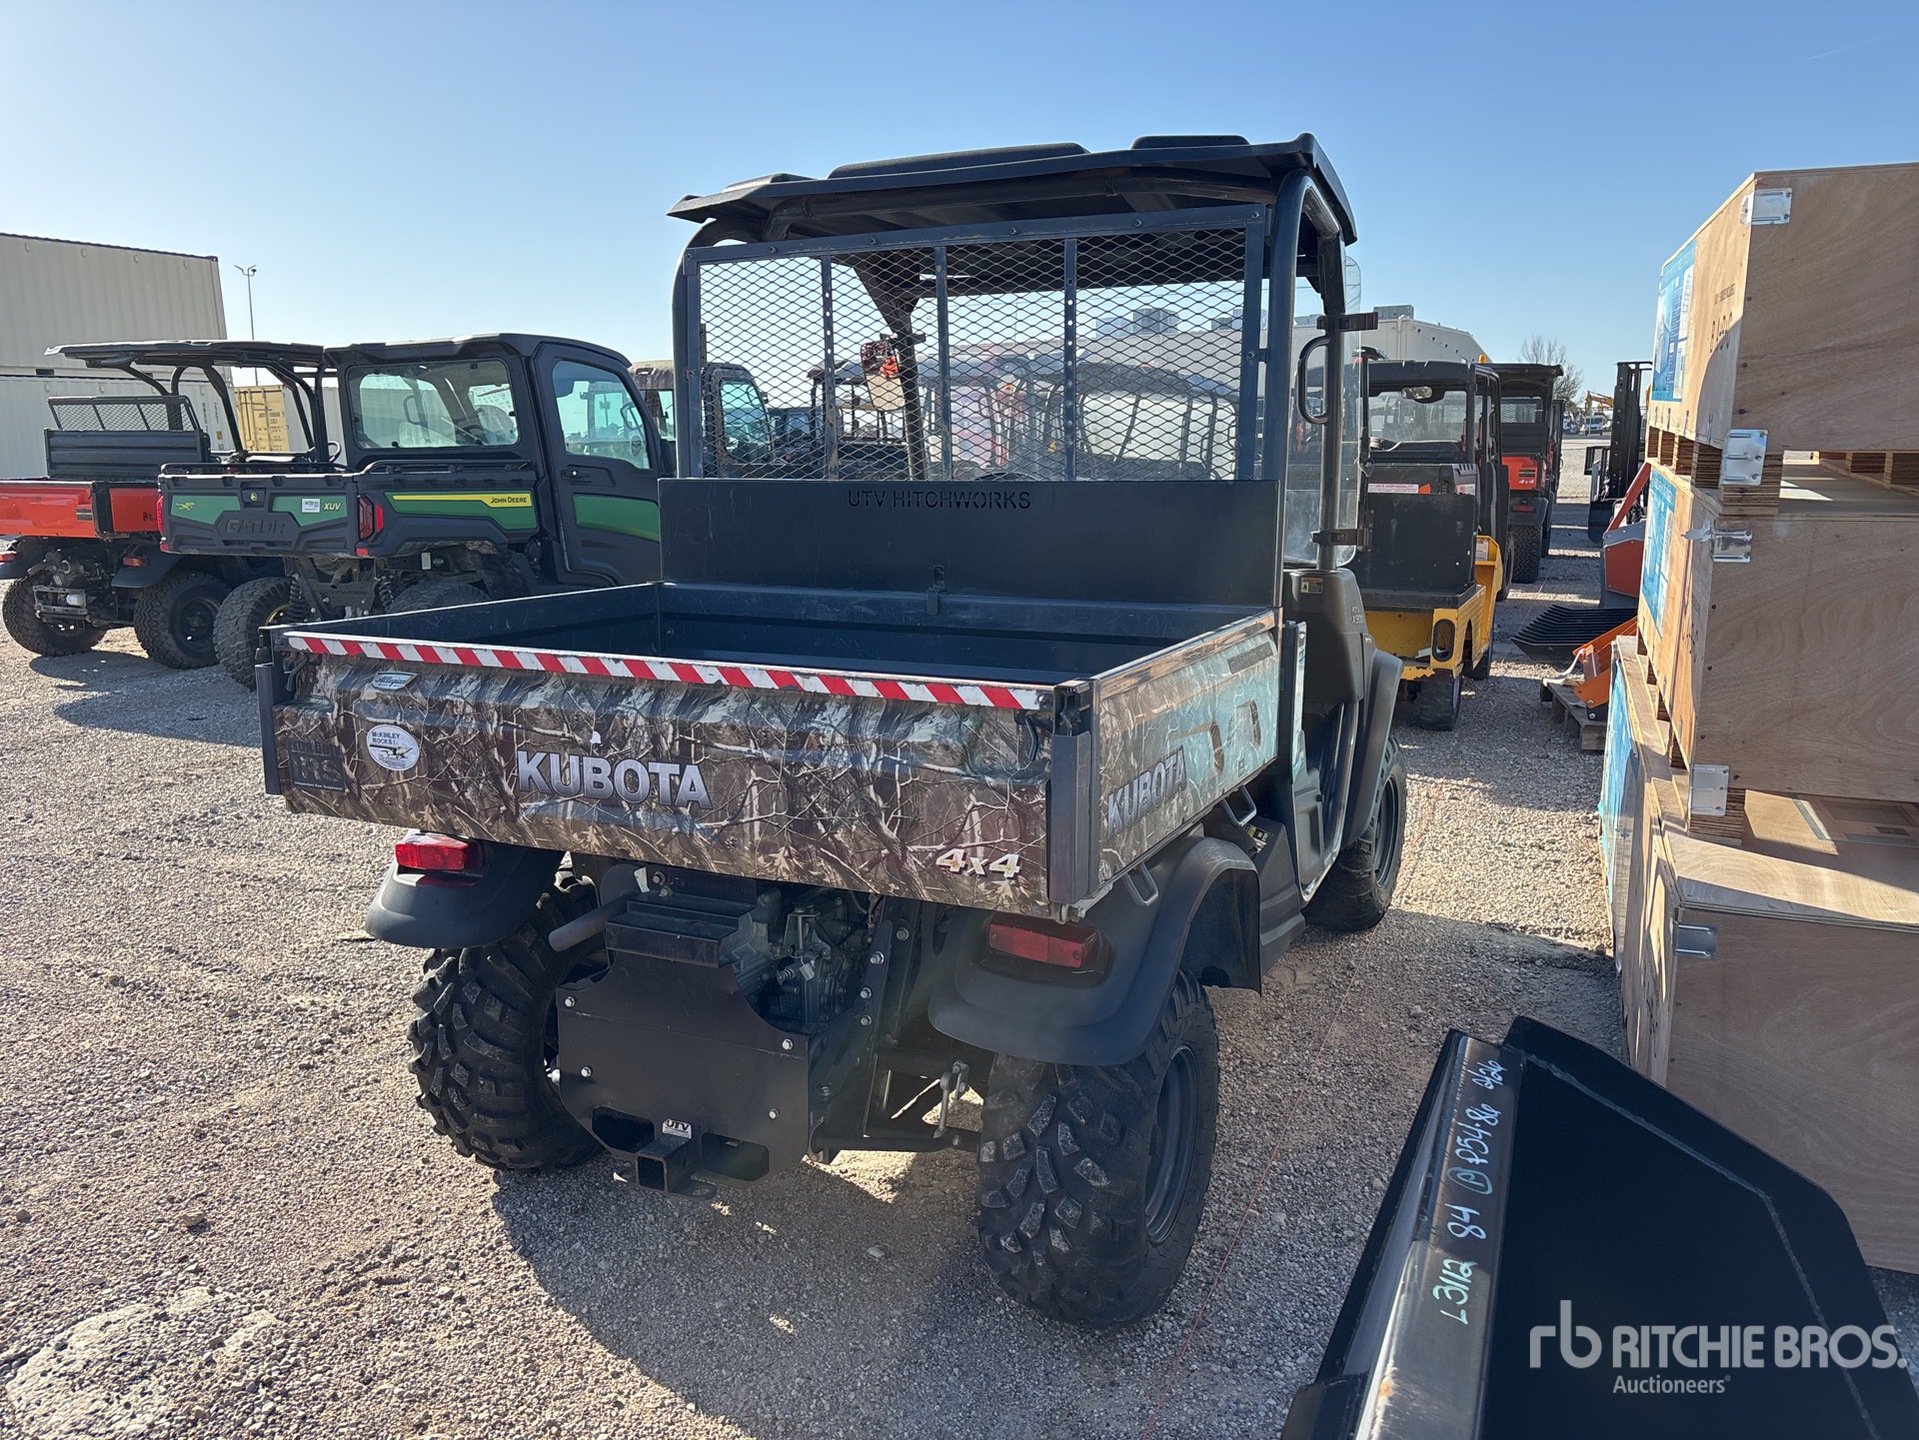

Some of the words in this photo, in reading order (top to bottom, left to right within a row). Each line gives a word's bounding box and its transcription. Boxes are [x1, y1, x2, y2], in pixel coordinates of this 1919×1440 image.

[324, 502, 341, 511] XUV
[490, 496, 506, 504] JOHN
[507, 496, 528, 504] DEERE
[848, 490, 886, 508] UTV
[892, 490, 1032, 509] HITCHWORKS
[225, 519, 286, 534] GATOR
[371, 731, 400, 740] McKINLEY
[517, 750, 713, 809] KUBOTA
[1107, 744, 1187, 840] KUBOTA
[935, 848, 1021, 878] 4x4
[666, 1119, 690, 1131] UTV
[1445, 1203, 1487, 1240] 84
